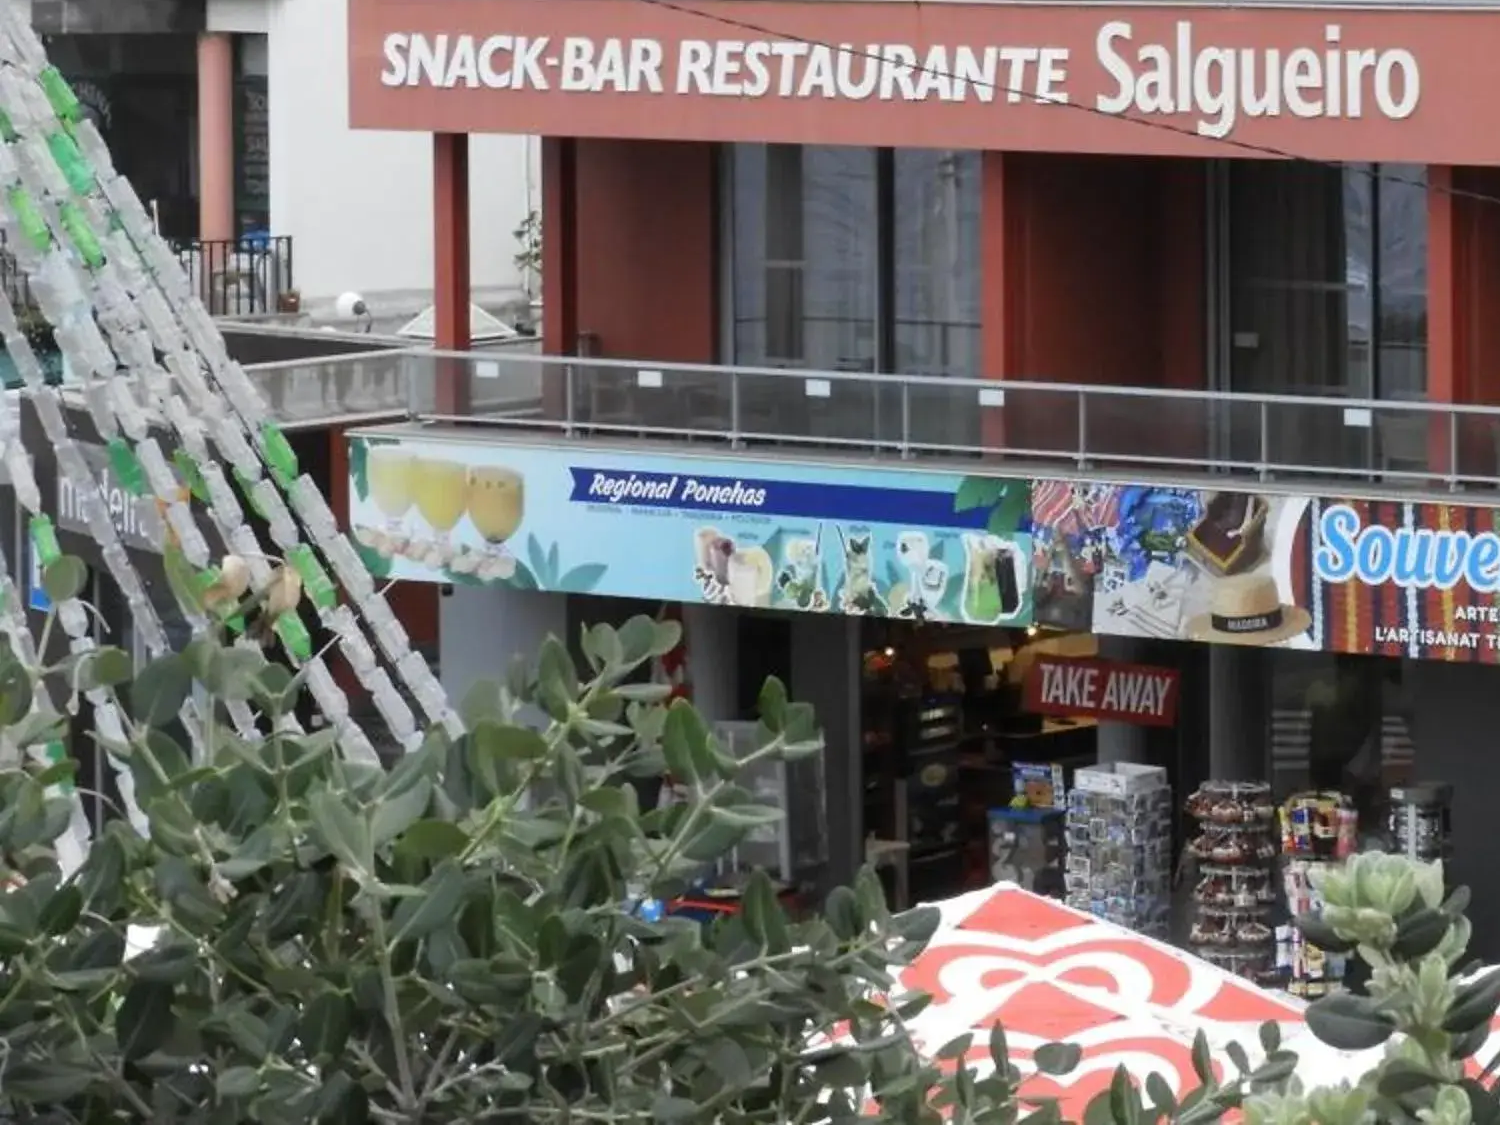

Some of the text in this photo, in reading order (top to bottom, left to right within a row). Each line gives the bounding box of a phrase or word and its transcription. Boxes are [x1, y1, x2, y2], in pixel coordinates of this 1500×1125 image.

[381, 20, 1420, 138] SNACK-BAR RESTAURANTE Salgueiro
[589, 473, 678, 502] Regional
[1040, 662, 1173, 716] TAKE AWAY
